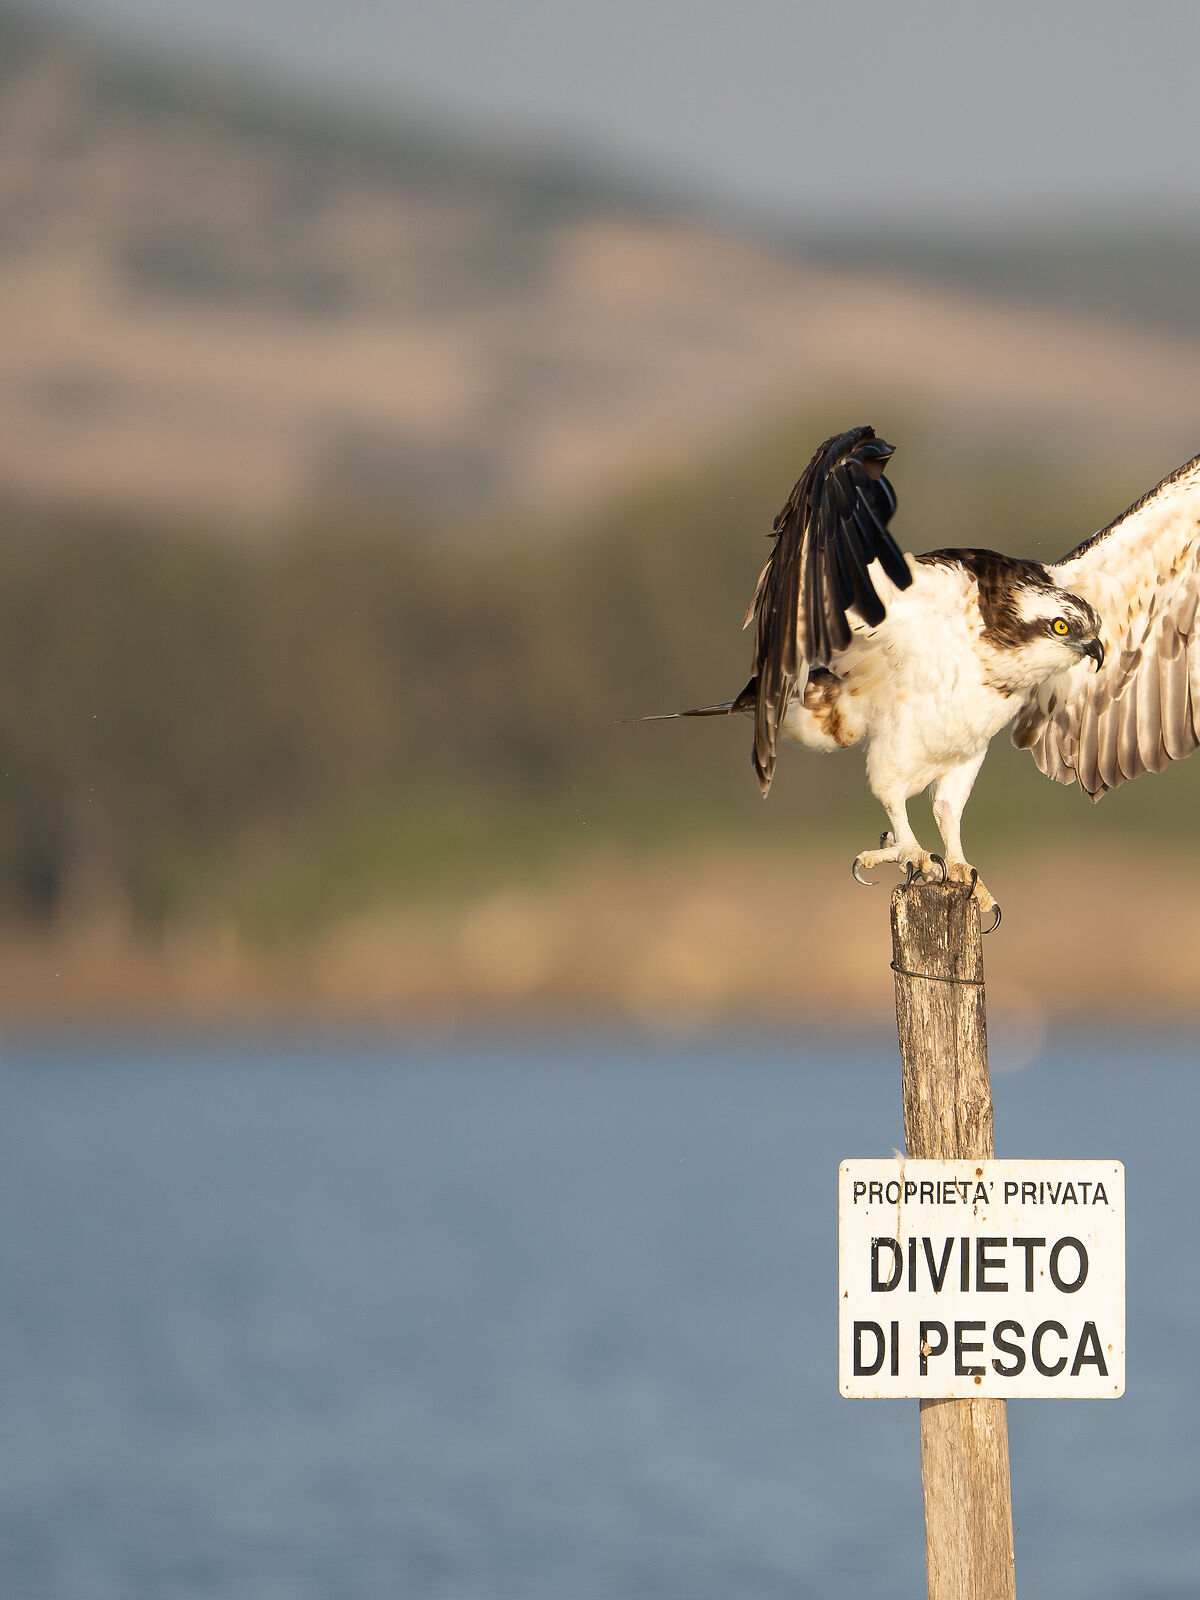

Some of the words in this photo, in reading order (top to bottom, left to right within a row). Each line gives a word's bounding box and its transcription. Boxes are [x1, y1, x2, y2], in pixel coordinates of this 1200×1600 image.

[1003, 1181, 1109, 1205] PRIVATA
[870, 1236, 1089, 1294] DIVIETO
[853, 1320, 899, 1377] DI
[918, 1319, 1109, 1377] PESCA
